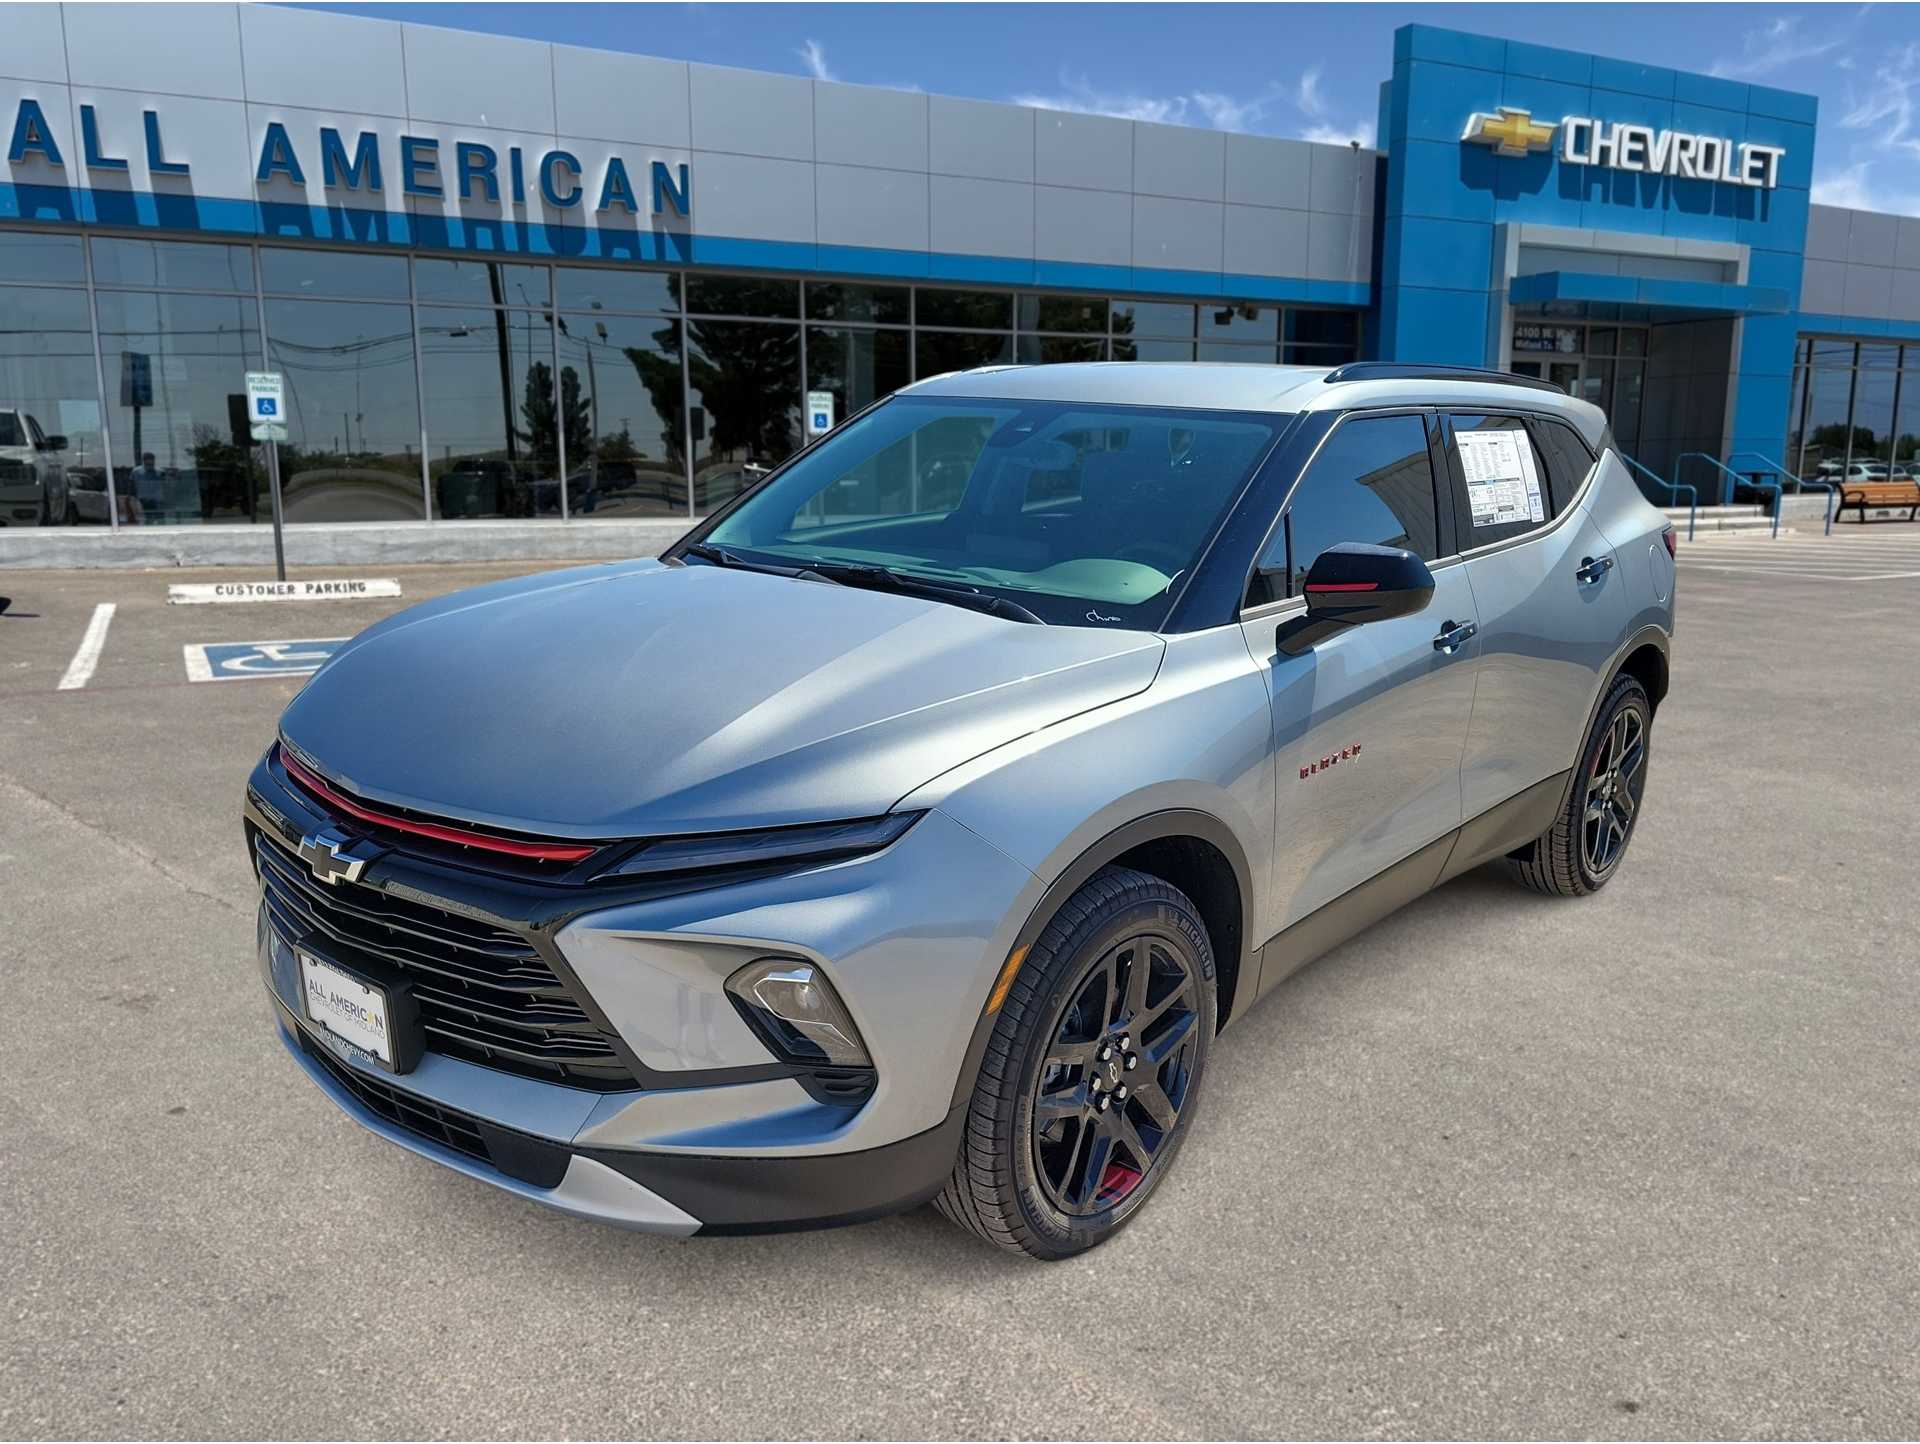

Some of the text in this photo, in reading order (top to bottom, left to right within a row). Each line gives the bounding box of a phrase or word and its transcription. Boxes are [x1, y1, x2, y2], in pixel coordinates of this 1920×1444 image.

[8, 99, 691, 217] ALL AMERICAN
[1560, 115, 1786, 189] CHEVROLET
[215, 582, 366, 596] CUSTOMER PARKING
[1300, 743, 1361, 780] BLAZER
[1179, 918, 1213, 980] MICHELIN
[308, 978, 327, 1000] ALL
